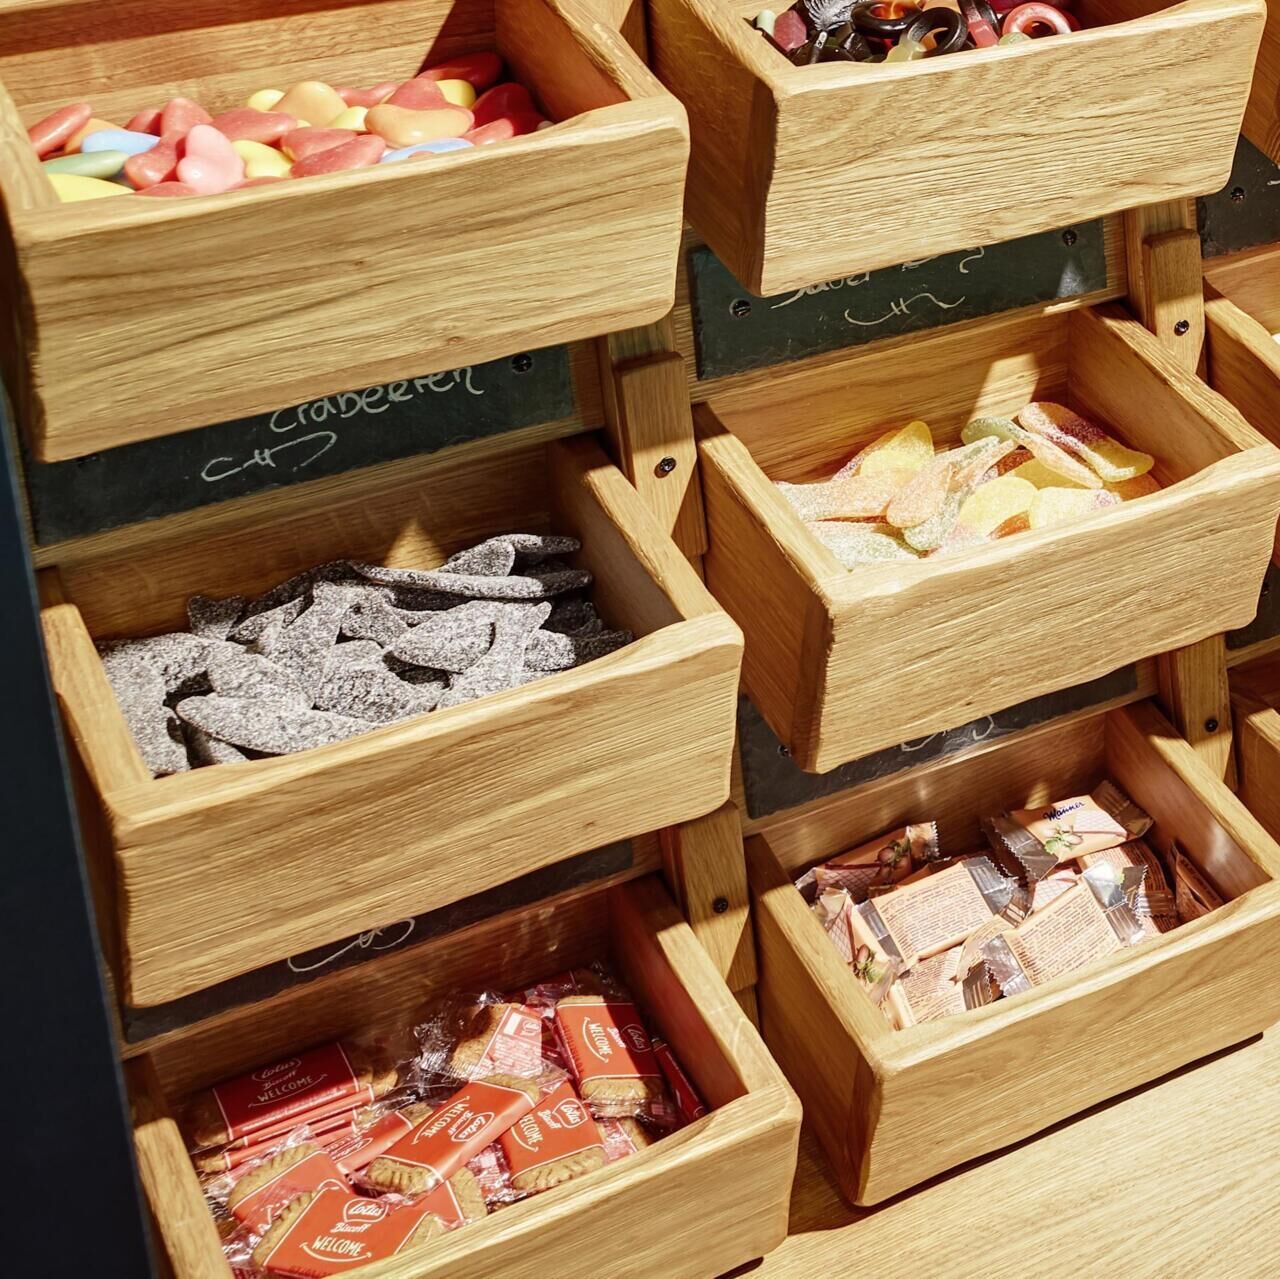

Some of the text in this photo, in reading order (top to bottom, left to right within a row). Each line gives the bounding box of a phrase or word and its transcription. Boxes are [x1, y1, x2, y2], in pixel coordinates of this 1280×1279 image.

[1042, 801, 1086, 822] Manner
[588, 1022, 613, 1056] WELCOME
[627, 1028, 646, 1050] Lotus
[260, 1060, 297, 1080] Lotus
[257, 1075, 313, 1103] WELCOME
[420, 1103, 470, 1139] WELCOME
[559, 1104, 582, 1125] Lotus
[458, 1115, 487, 1139] Lotus
[347, 1200, 386, 1218] Lotus
[329, 1221, 373, 1234] Biscoff
[311, 1234, 367, 1257] WELCOME
